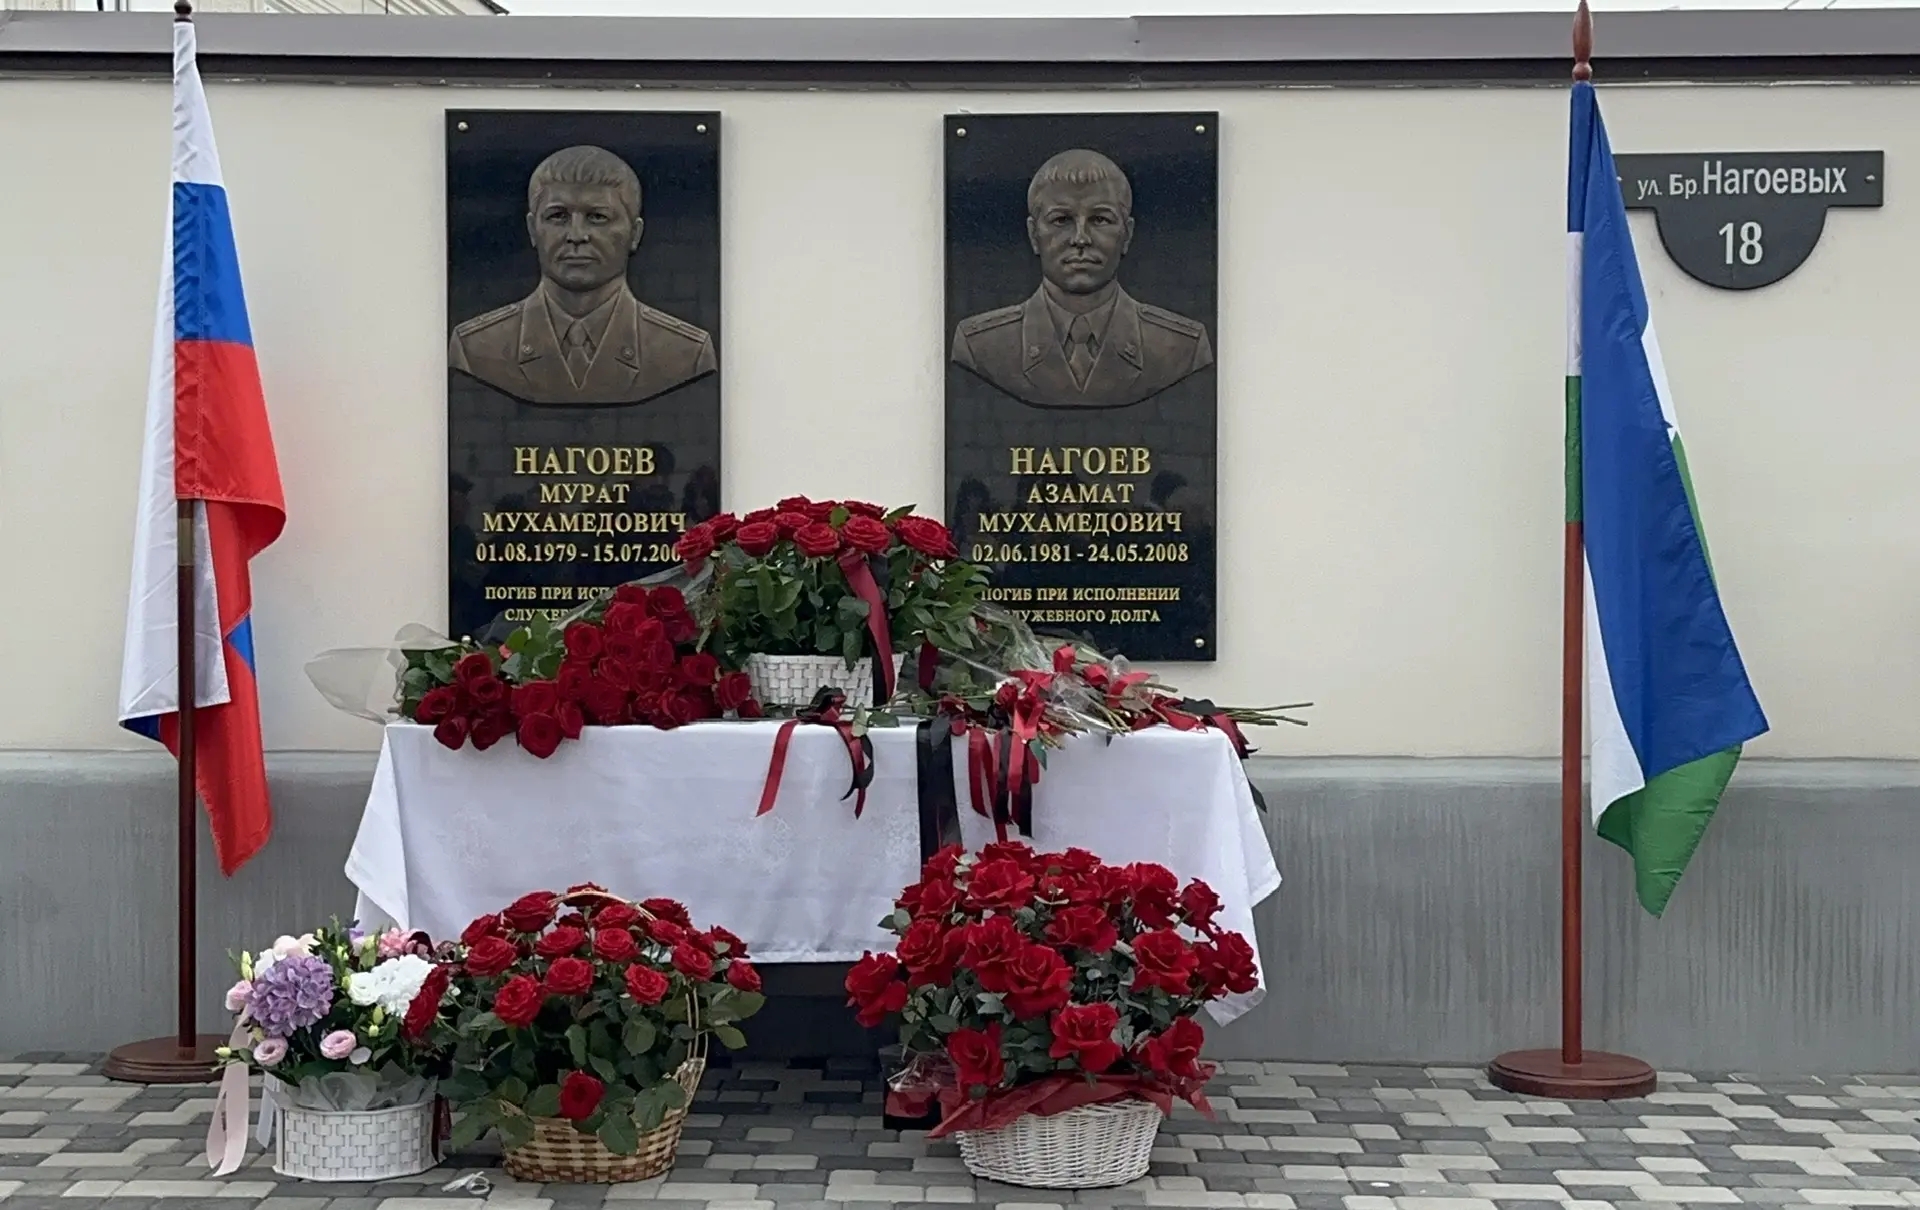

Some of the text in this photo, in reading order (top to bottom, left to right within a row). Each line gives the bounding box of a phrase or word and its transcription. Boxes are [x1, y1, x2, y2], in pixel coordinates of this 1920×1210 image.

[1637, 179, 1663, 200] ул.
[1703, 160, 1847, 195] Нагоевых
[1718, 221, 1763, 265] 18
[514, 447, 655, 475] НАГОЕВ
[1009, 447, 1151, 475] НАГОЕВ
[539, 483, 630, 504] МУРАТ
[1026, 483, 1135, 504] АЗАМАТ
[482, 512, 686, 537] МУХАМЕДОВИЧ
[979, 512, 1182, 537] МУХАМЕДОВИЧ
[476, 543, 577, 562] 01.08.1979
[594, 543, 687, 562] 15.07.200
[972, 543, 1071, 562] 02.06.1981
[1088, 543, 1189, 562] 24.05.2008
[485, 586, 537, 600] ПОГИБ
[541, 586, 573, 600] ПРИ
[981, 587, 1180, 601] ПОГИБ ПРИ ИСПОЛНЕНИИ
[1109, 609, 1161, 624] ДОЛГА
